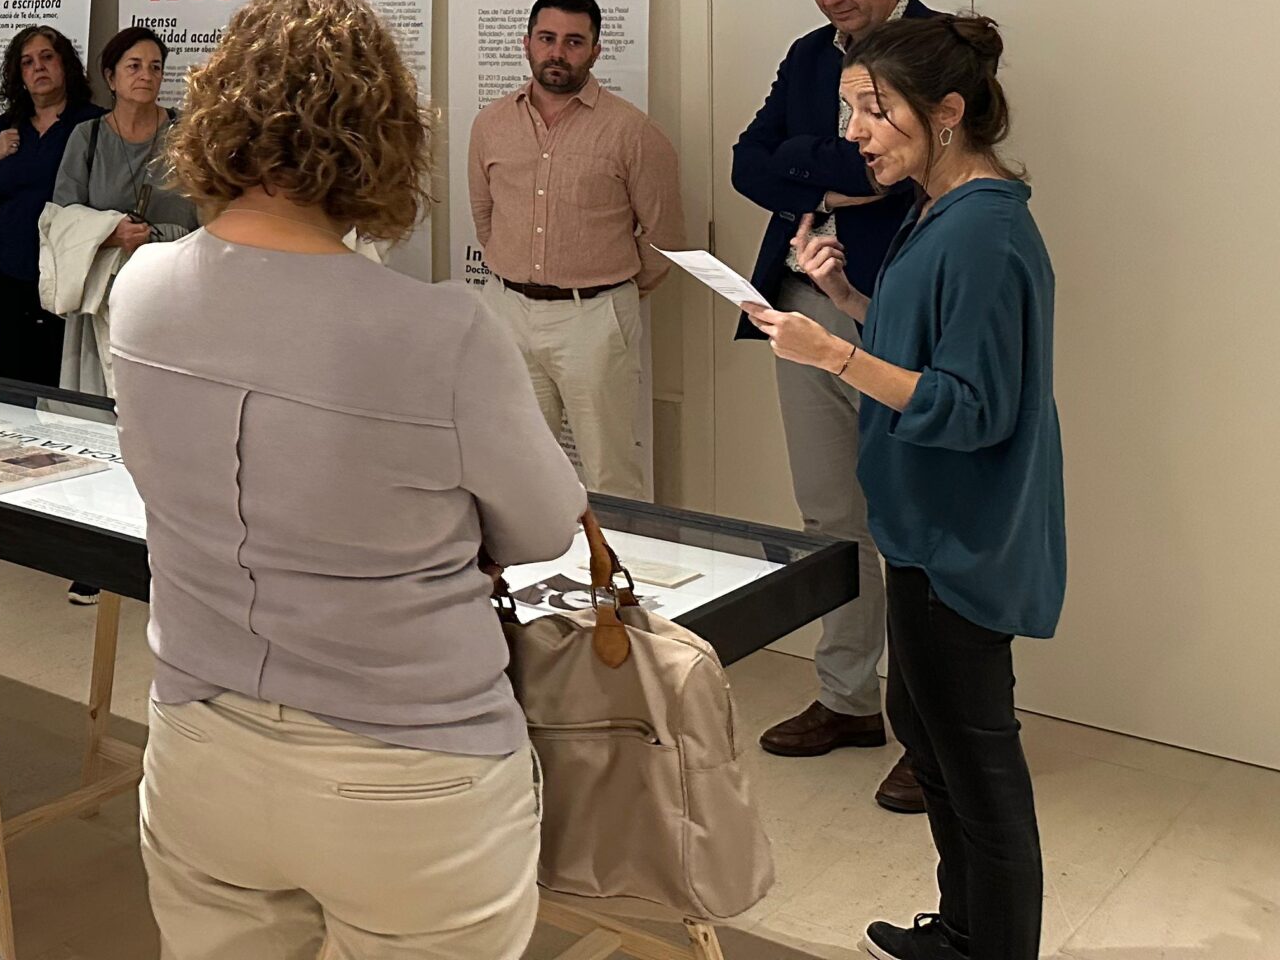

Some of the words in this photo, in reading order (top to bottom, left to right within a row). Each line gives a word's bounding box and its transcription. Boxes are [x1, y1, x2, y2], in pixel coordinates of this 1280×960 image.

[3, 0, 9, 9] a
[131, 14, 177, 28] Intensa
[190, 29, 222, 43] acadè
